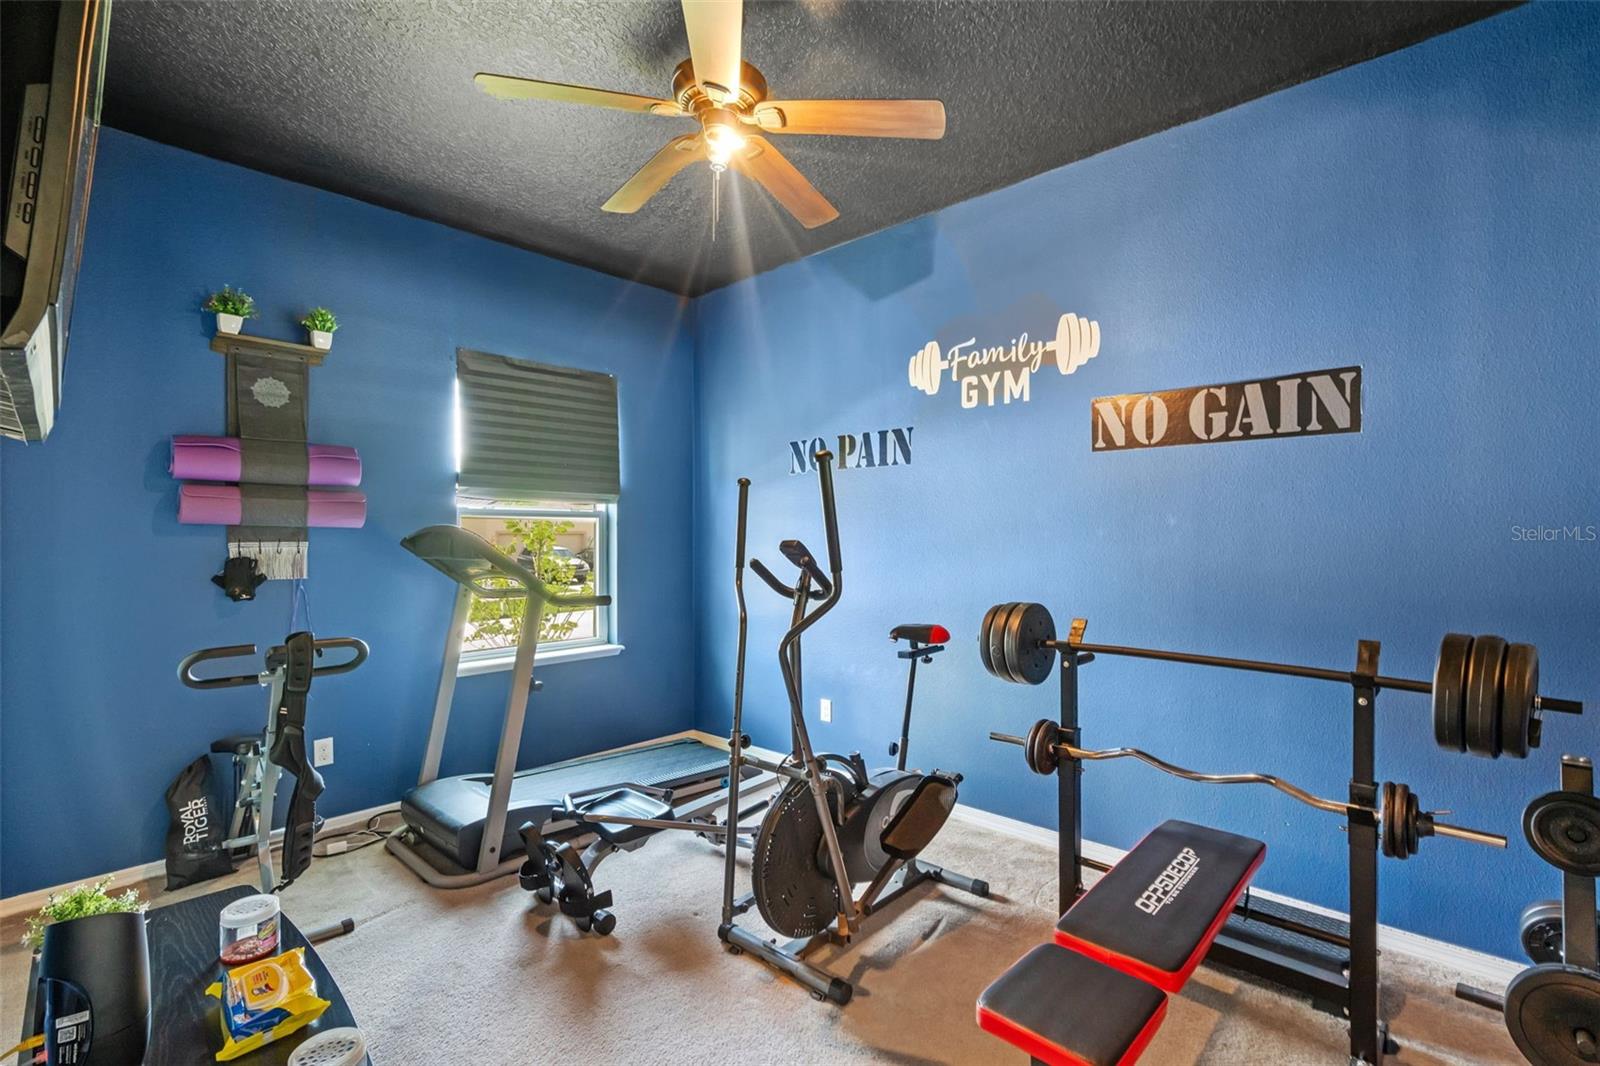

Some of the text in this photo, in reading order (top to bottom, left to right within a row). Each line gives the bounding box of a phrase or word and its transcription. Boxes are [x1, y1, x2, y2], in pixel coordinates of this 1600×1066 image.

[947, 332, 1045, 381] Family
[961, 367, 1030, 409] GYM
[1094, 371, 1357, 448] NO GAIN
[789, 426, 914, 474] NO PAIN
[179, 800, 196, 845] ROYAL
[191, 797, 208, 842] TIGER
